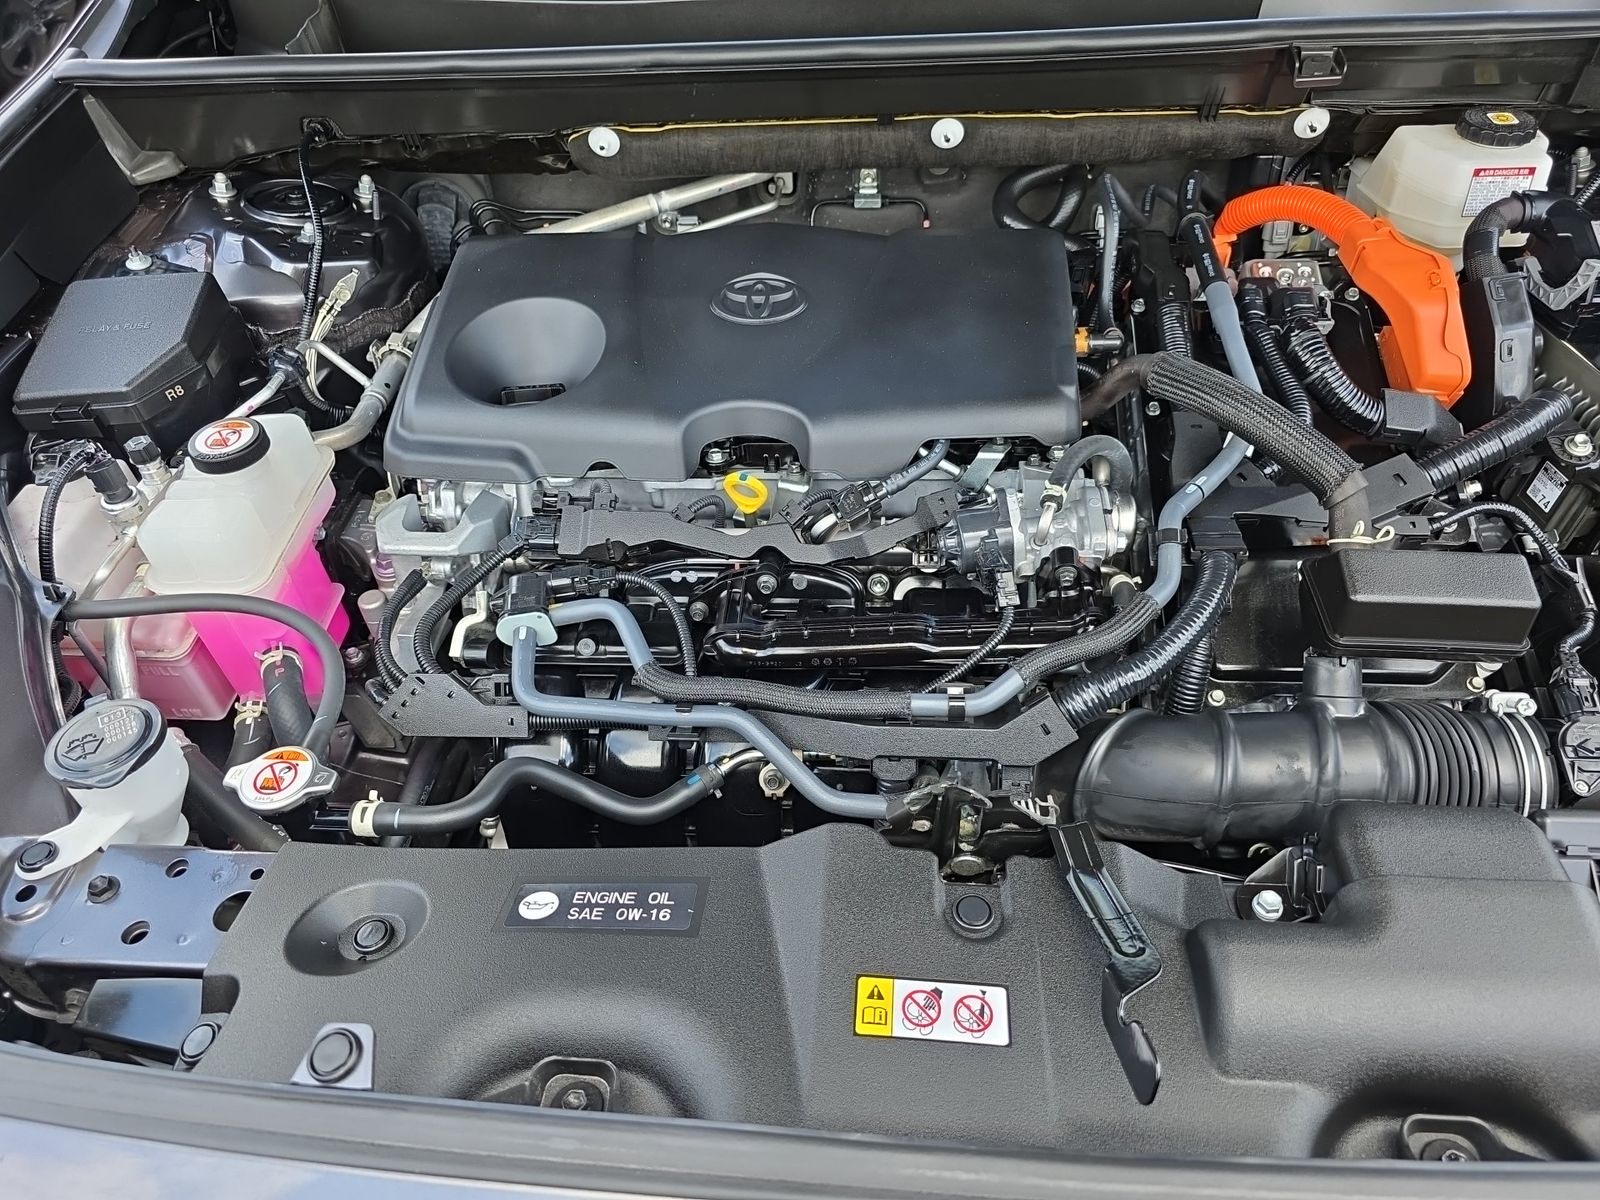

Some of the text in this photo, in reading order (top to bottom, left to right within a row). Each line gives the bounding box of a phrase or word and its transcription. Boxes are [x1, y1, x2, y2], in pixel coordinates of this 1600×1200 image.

[1494, 168, 1519, 176] DANGER
[123, 321, 151, 330] FUSE
[165, 385, 184, 401] R8
[1538, 494, 1551, 509] 74
[572, 891, 674, 904] ENGINE OIL
[567, 908, 671, 921] SAE 0W-16
